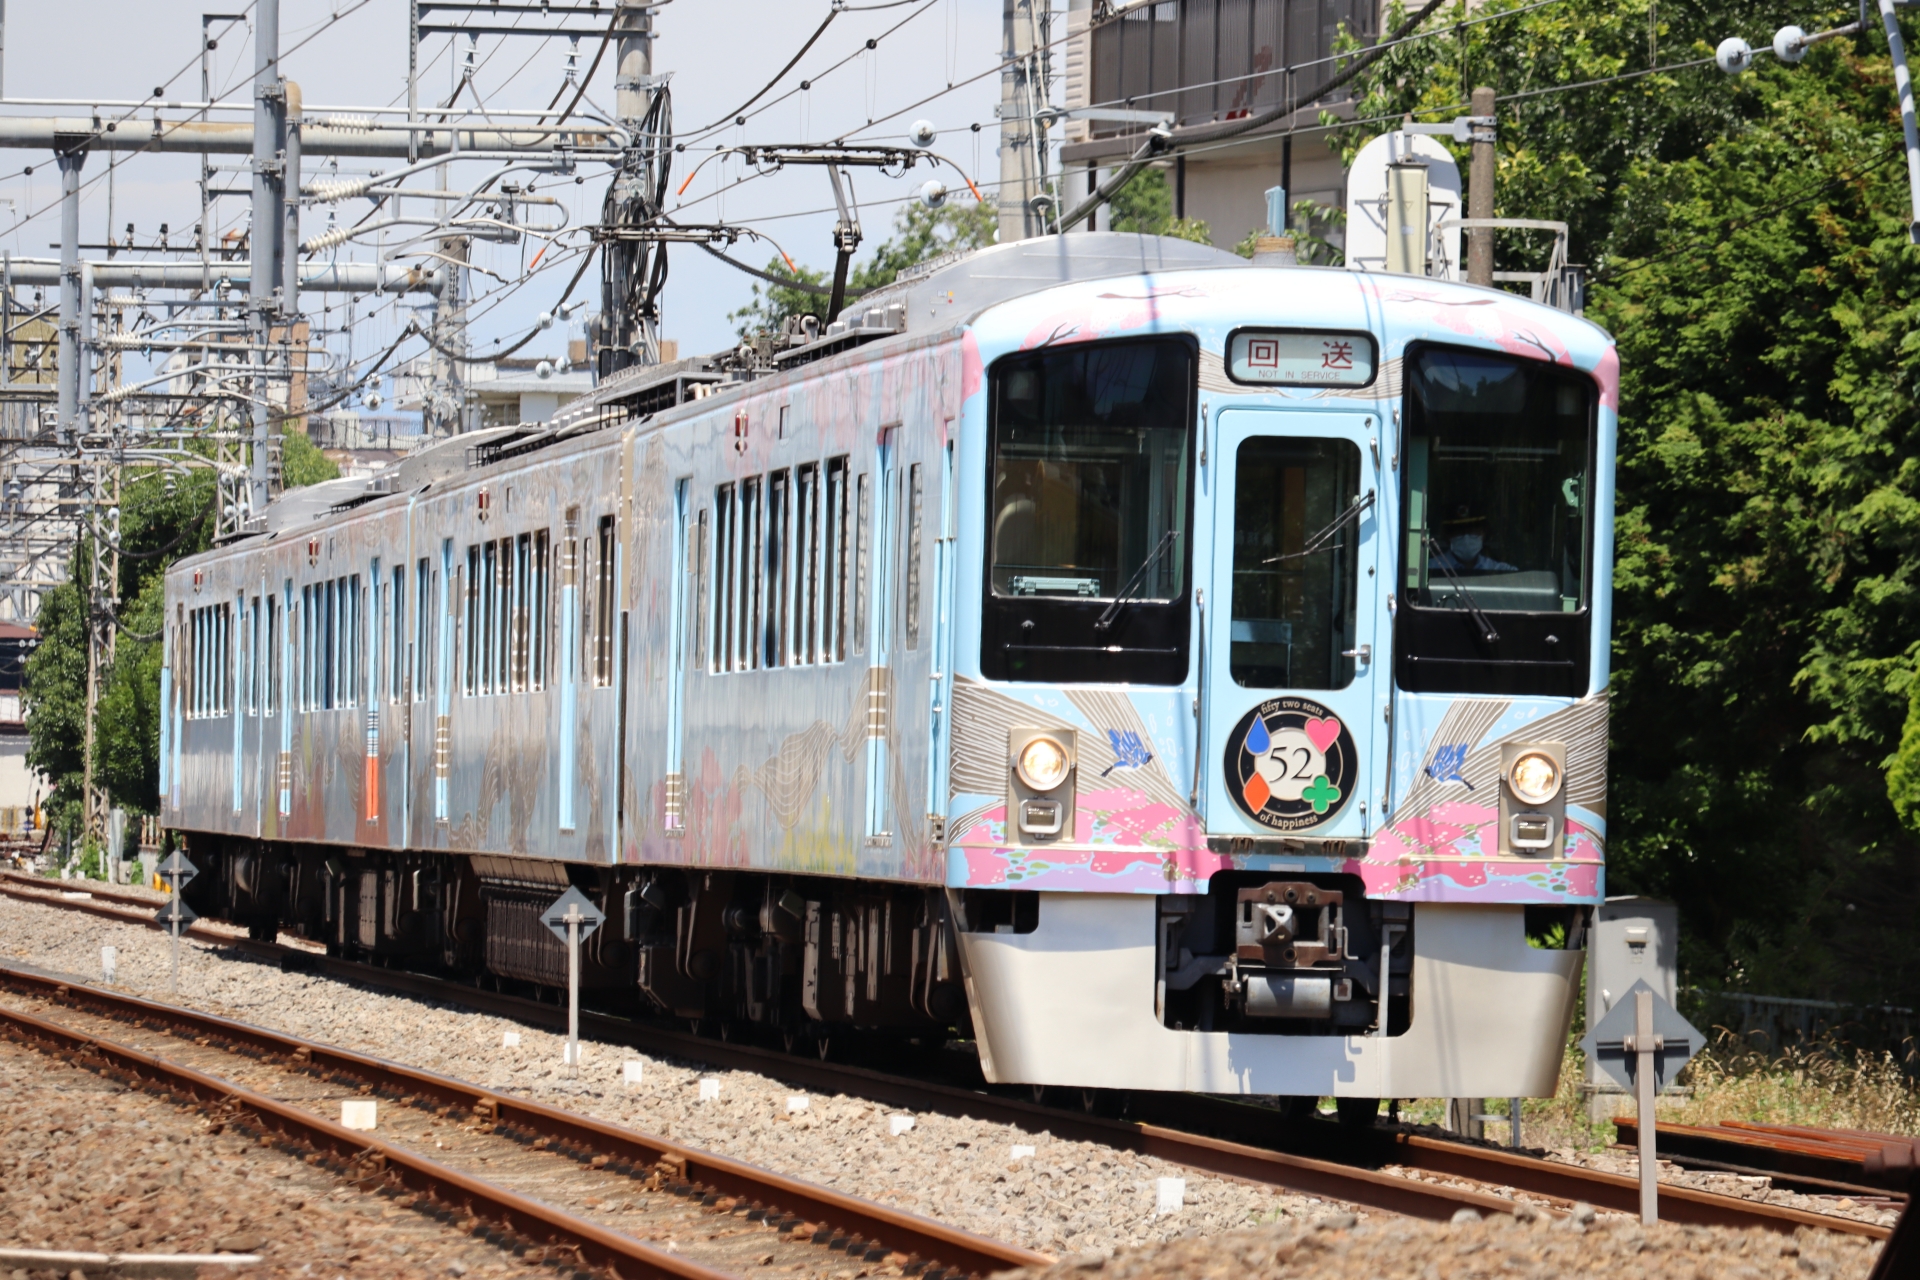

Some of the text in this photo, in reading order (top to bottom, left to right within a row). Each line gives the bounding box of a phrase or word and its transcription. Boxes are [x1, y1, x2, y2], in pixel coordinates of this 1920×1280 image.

[1248, 339, 1353, 370] 回送
[1258, 370, 1342, 380] NOT IN SERVICE
[1260, 700, 1324, 717] fifty two seats
[1269, 746, 1314, 784] 52
[1260, 813, 1318, 830] of happiness
